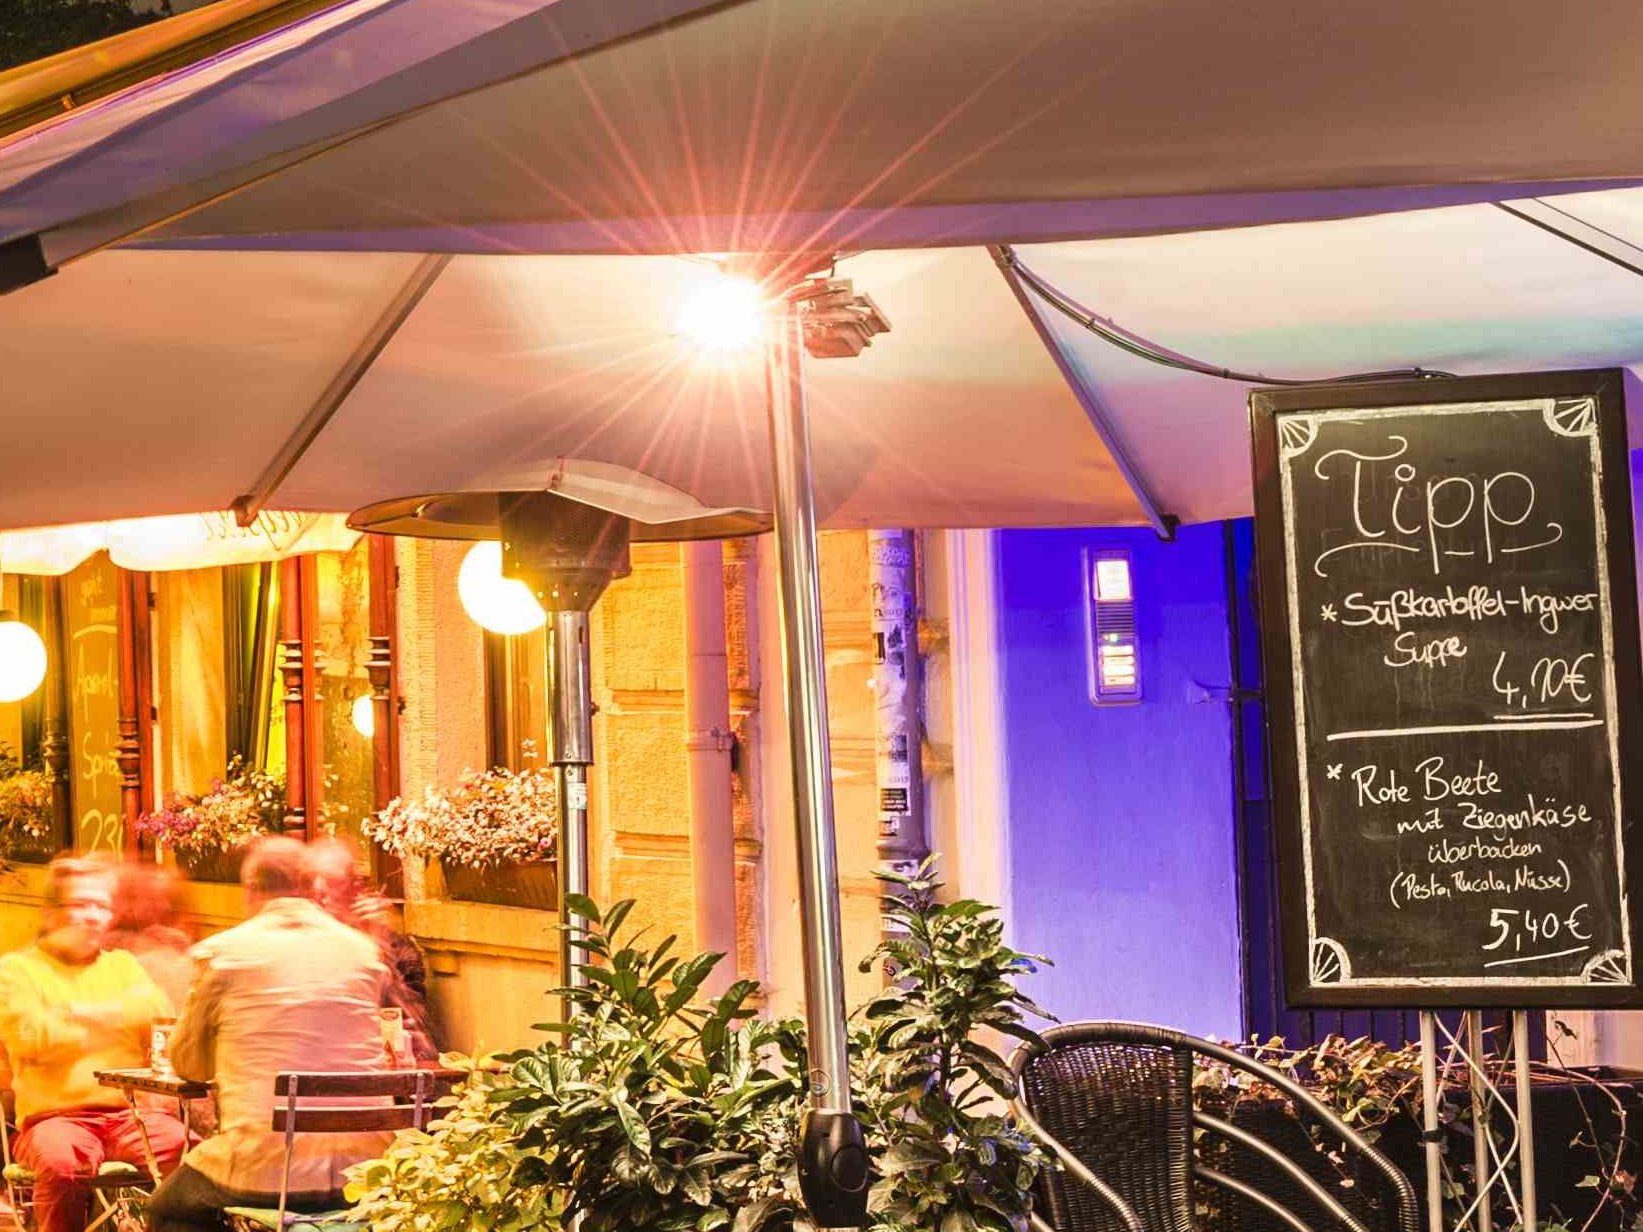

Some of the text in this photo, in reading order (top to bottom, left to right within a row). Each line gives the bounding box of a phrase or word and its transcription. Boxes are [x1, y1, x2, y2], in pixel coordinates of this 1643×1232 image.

[1314, 435, 1536, 575] Tipp
[1383, 631, 1468, 668] Suppe
[1351, 755, 1503, 807] Rote Beete
[1396, 793, 1593, 842] mit Ziegenkäse
[1427, 835, 1543, 864] überbacken
[1389, 858, 1571, 910] (Pesto, Rucola, Nüsse)
